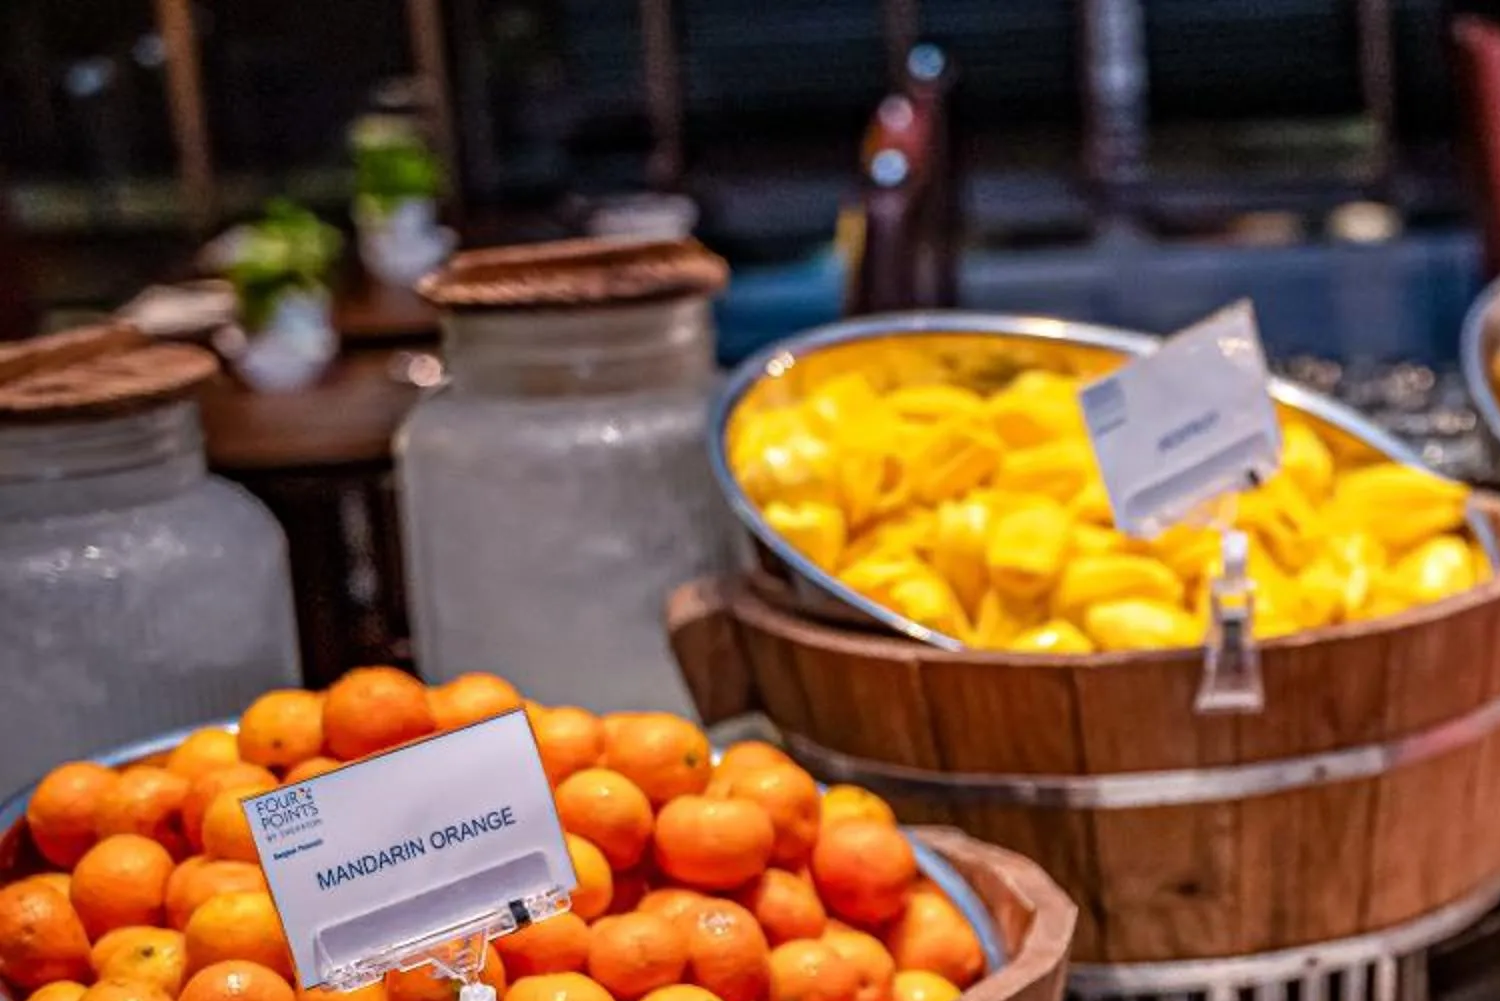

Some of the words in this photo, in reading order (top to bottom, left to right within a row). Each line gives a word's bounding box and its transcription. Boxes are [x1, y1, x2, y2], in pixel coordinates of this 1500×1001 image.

[256, 790, 301, 816] FOUR
[261, 801, 319, 830] POINTS
[316, 837, 426, 890] MANDARIN
[429, 806, 516, 850] ORANGE
